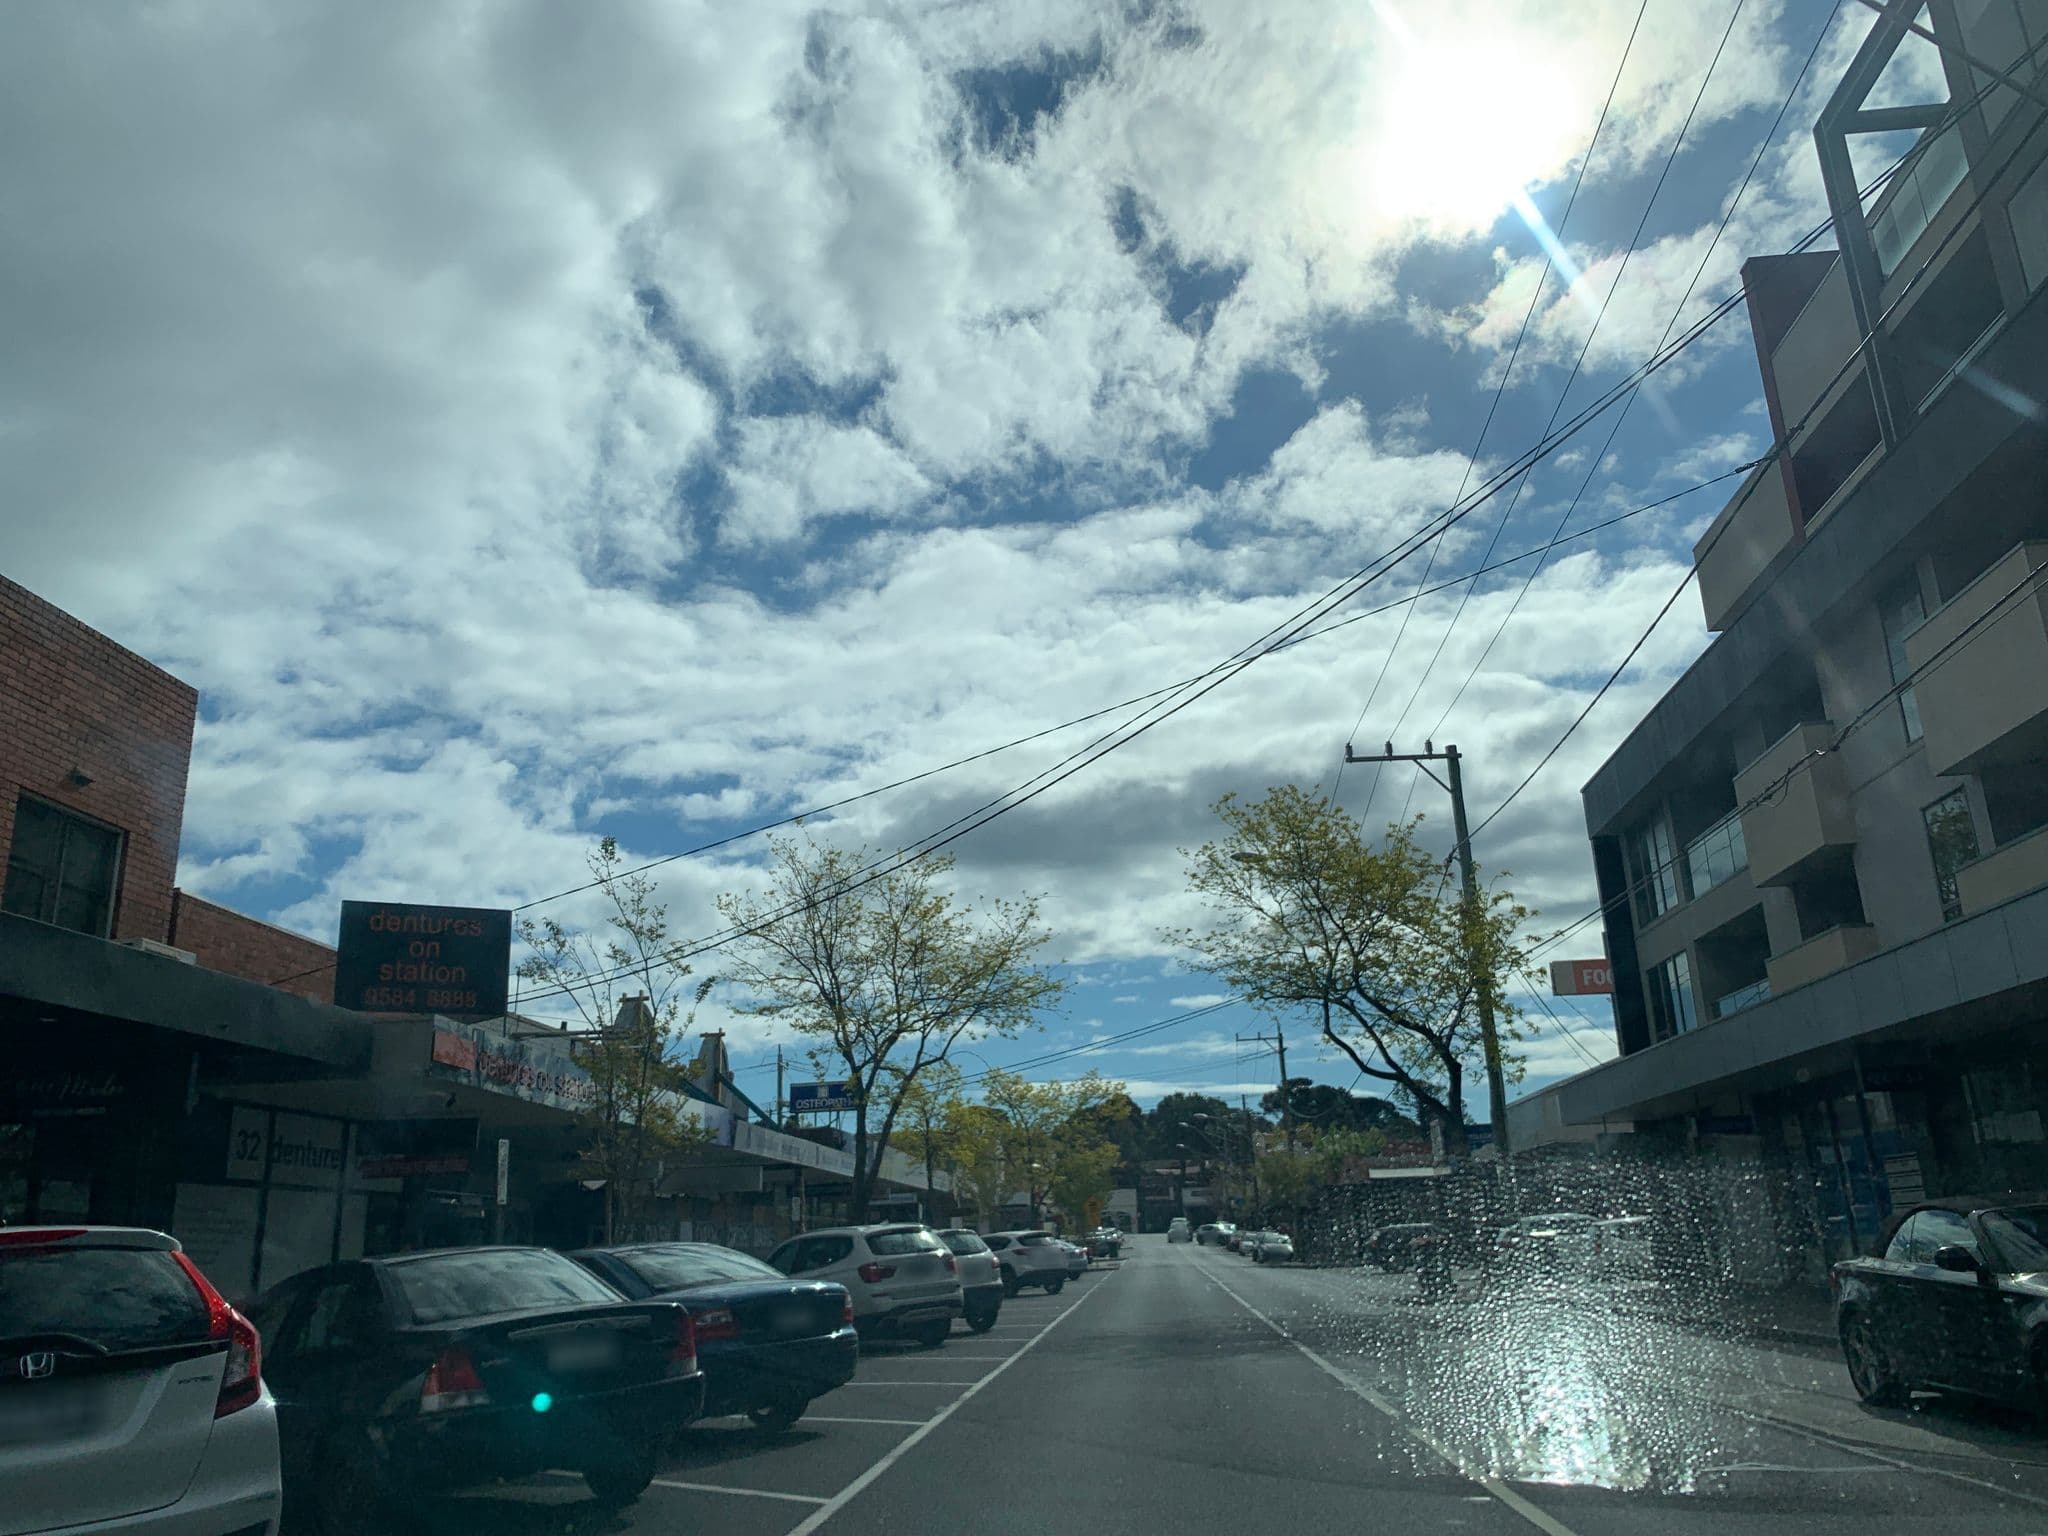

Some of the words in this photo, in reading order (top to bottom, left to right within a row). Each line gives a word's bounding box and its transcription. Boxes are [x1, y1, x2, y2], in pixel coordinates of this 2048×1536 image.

[369, 908, 482, 937] dentures
[408, 940, 441, 959] on
[379, 960, 467, 983] station
[236, 1129, 261, 1161] 32
